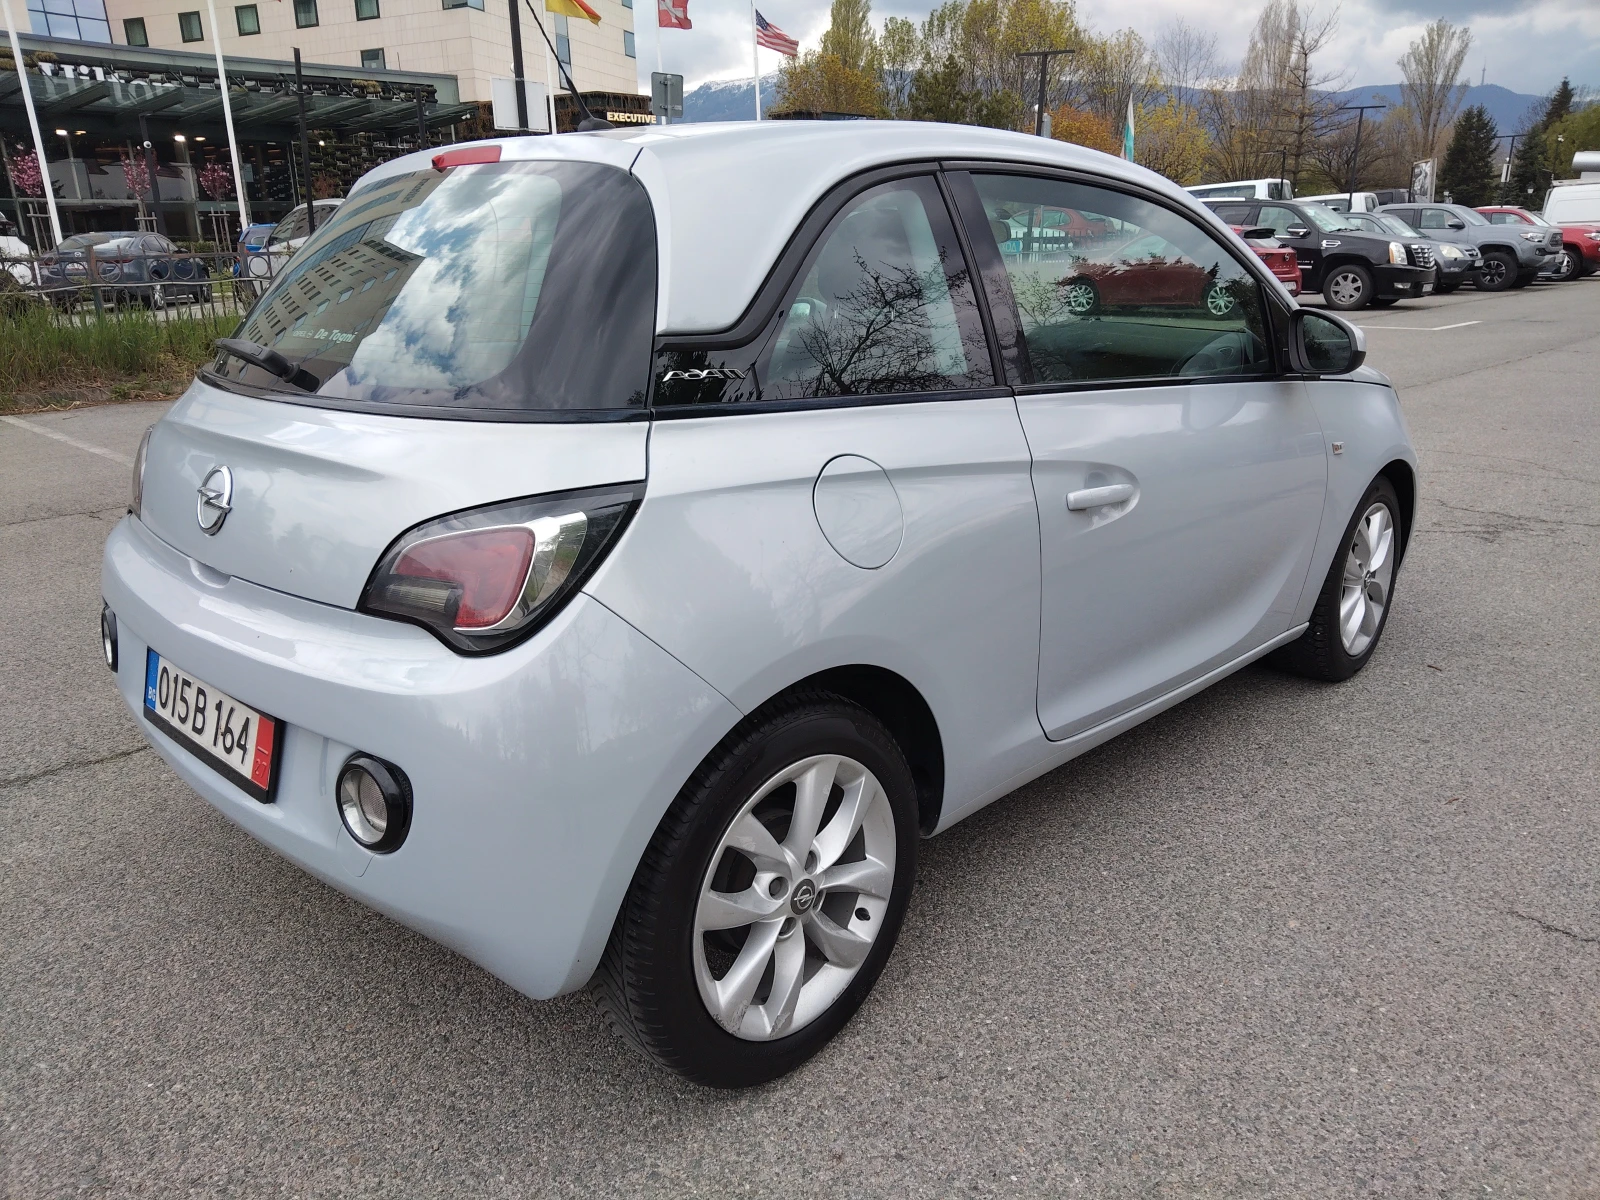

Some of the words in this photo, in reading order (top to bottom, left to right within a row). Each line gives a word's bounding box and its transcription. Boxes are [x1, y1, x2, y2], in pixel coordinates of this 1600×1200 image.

[607, 111, 657, 124] EXECUTIVE
[314, 328, 329, 340] De
[329, 329, 359, 344] Togni
[148, 685, 157, 702] BG
